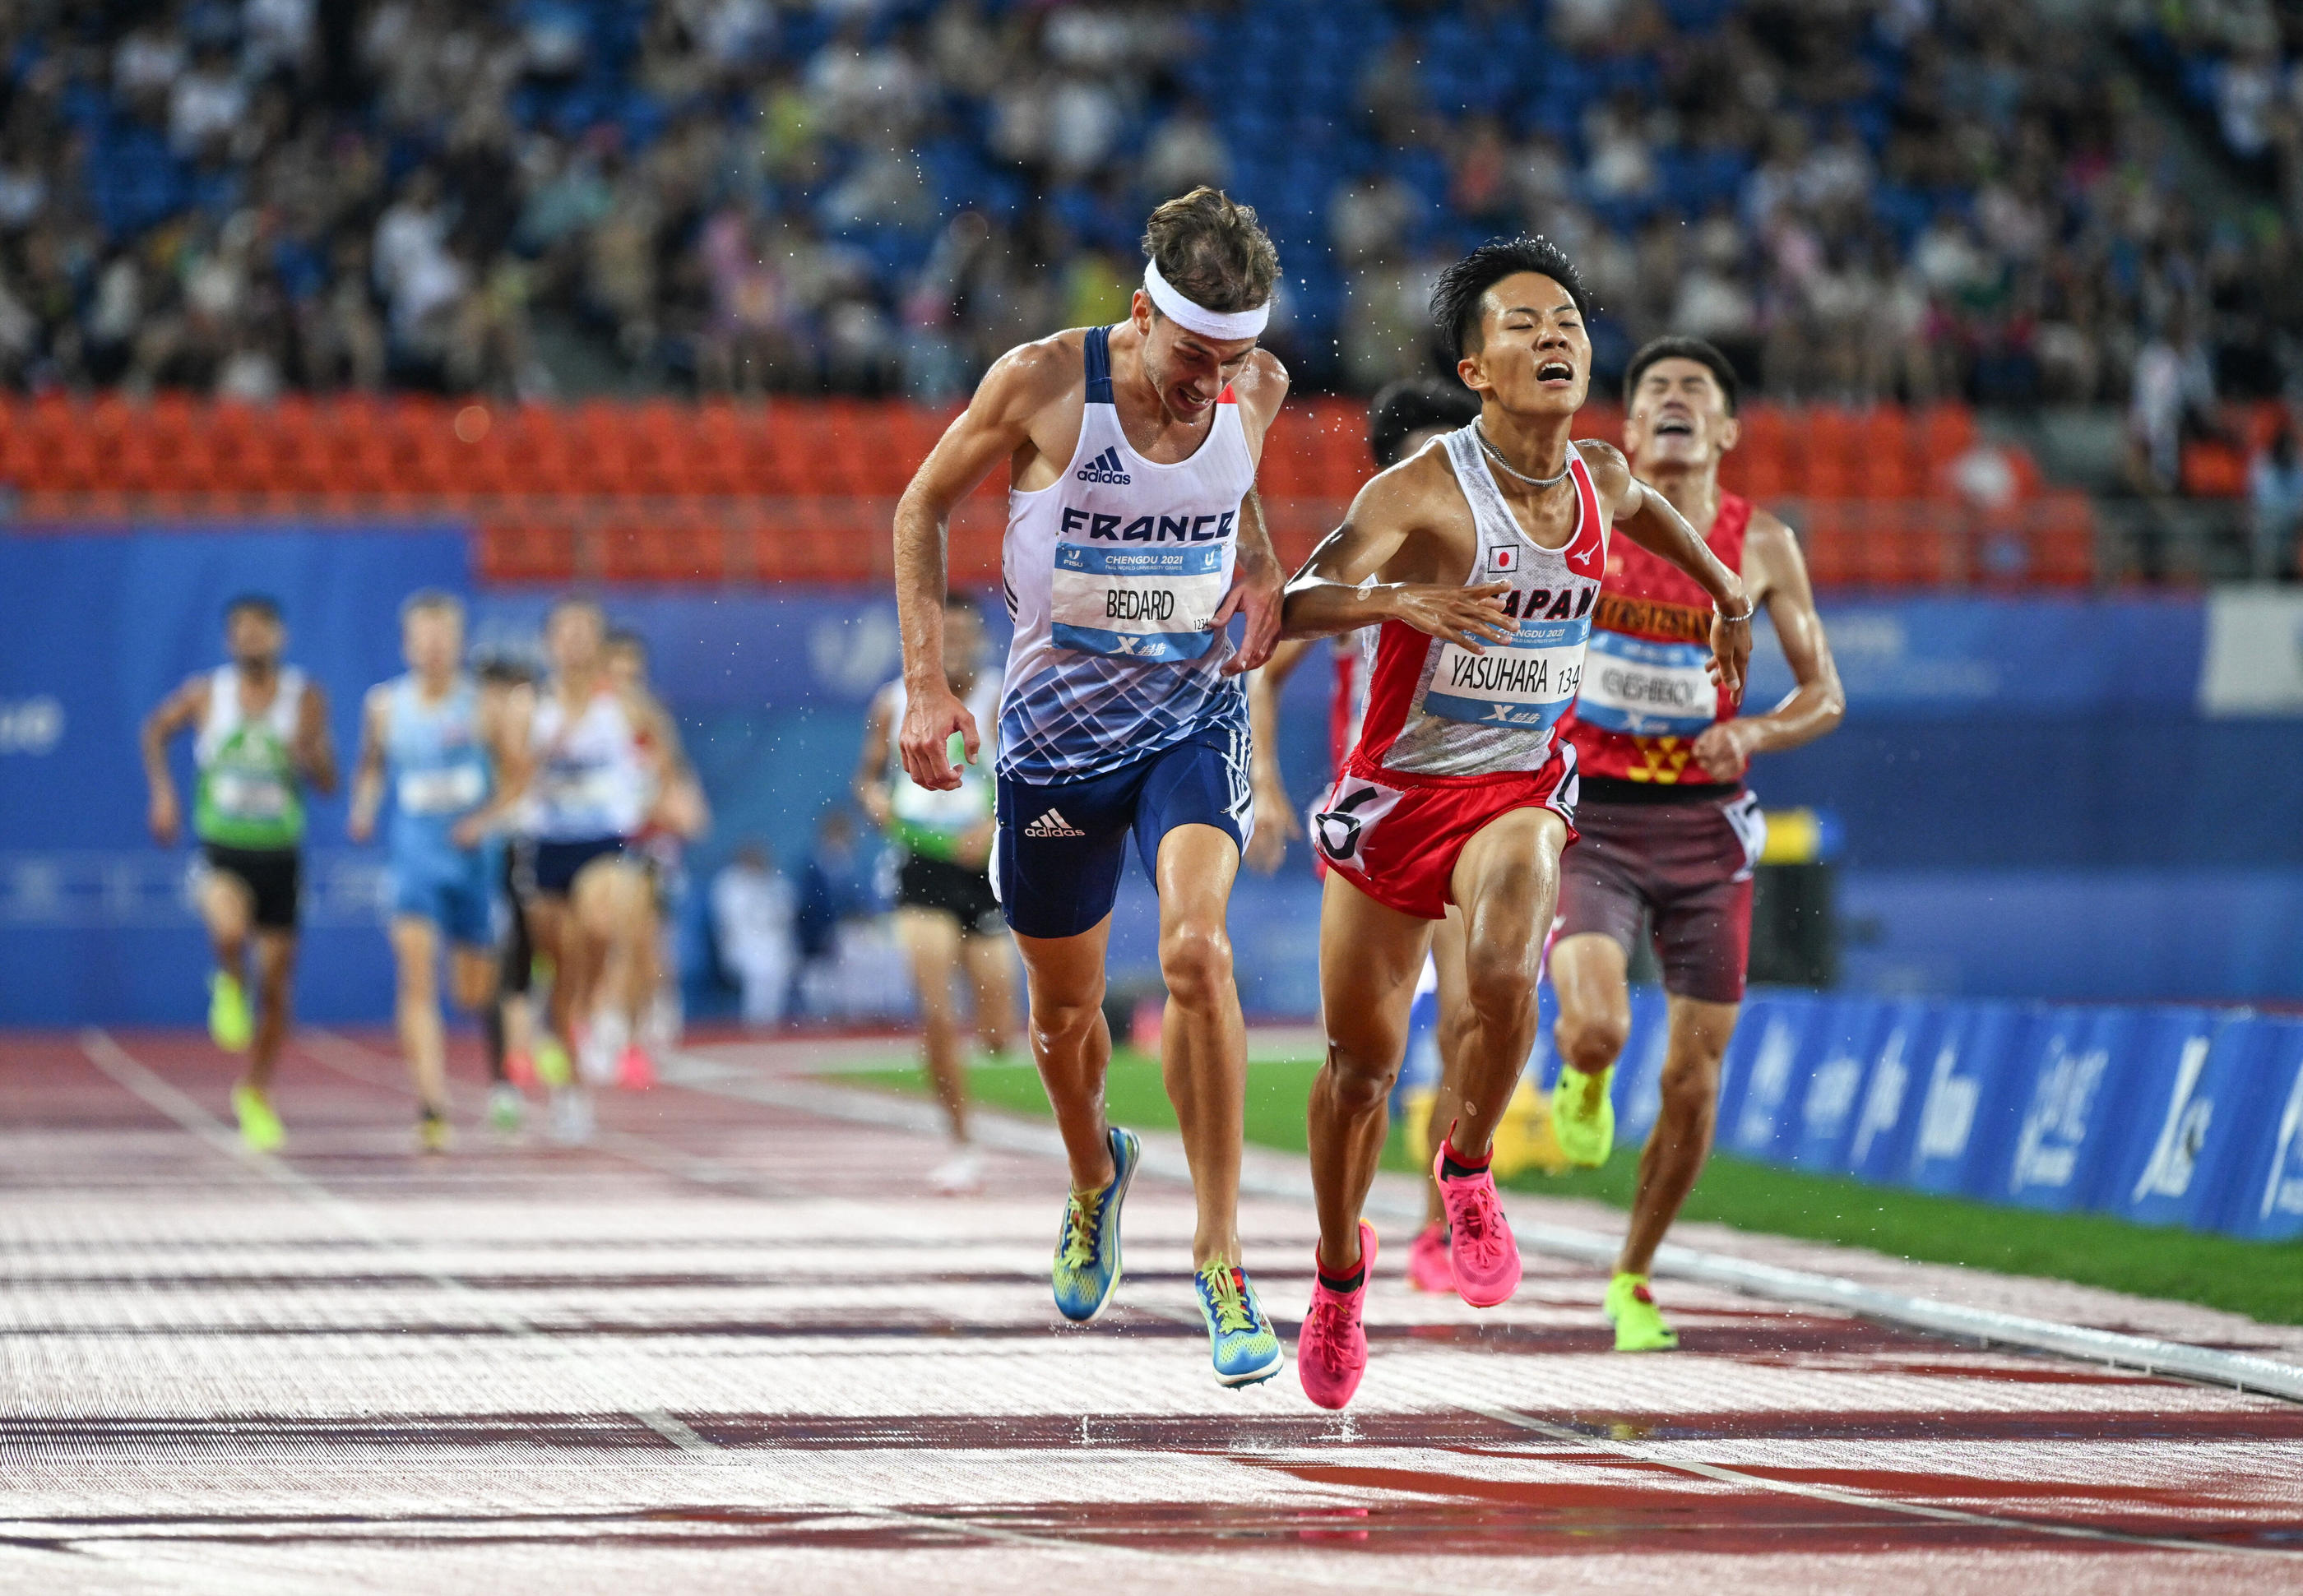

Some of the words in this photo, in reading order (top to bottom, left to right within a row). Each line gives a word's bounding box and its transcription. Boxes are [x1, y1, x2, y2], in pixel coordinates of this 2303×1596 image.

[1077, 470, 1131, 485] adidas
[1060, 507, 1235, 542] FRANCE
[1063, 559, 1083, 567] FISU
[1105, 555, 1158, 564] CHENGDU
[1160, 555, 1184, 564] 2021
[1105, 589, 1175, 621] BEDARD
[1491, 585, 1597, 620] APAN
[1546, 628, 1566, 638] 2021
[1450, 655, 1548, 693] YASUHARA
[1024, 826, 1086, 838] adidas
